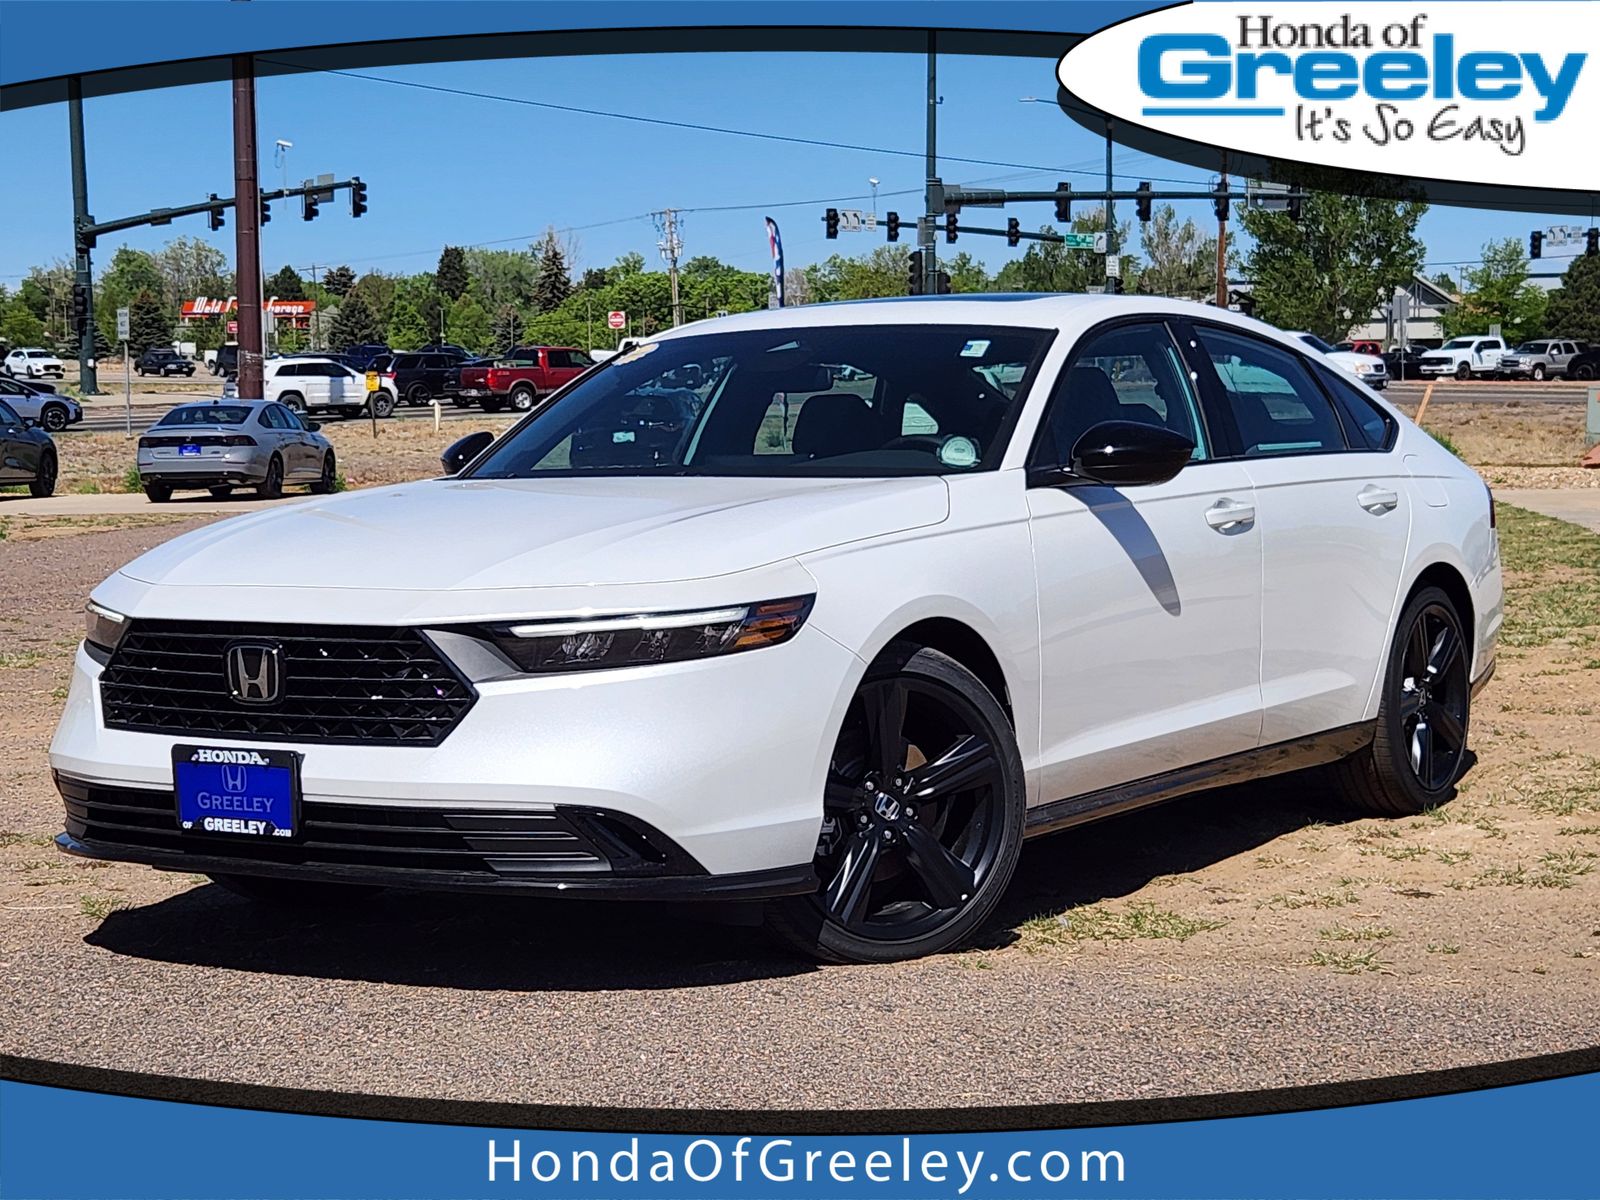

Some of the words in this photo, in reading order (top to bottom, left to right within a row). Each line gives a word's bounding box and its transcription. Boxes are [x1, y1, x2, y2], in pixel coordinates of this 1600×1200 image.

[193, 296, 223, 313] Weld
[197, 749, 266, 765] HONDA
[197, 792, 274, 813] GREELEY
[204, 817, 267, 835] GREELEY
